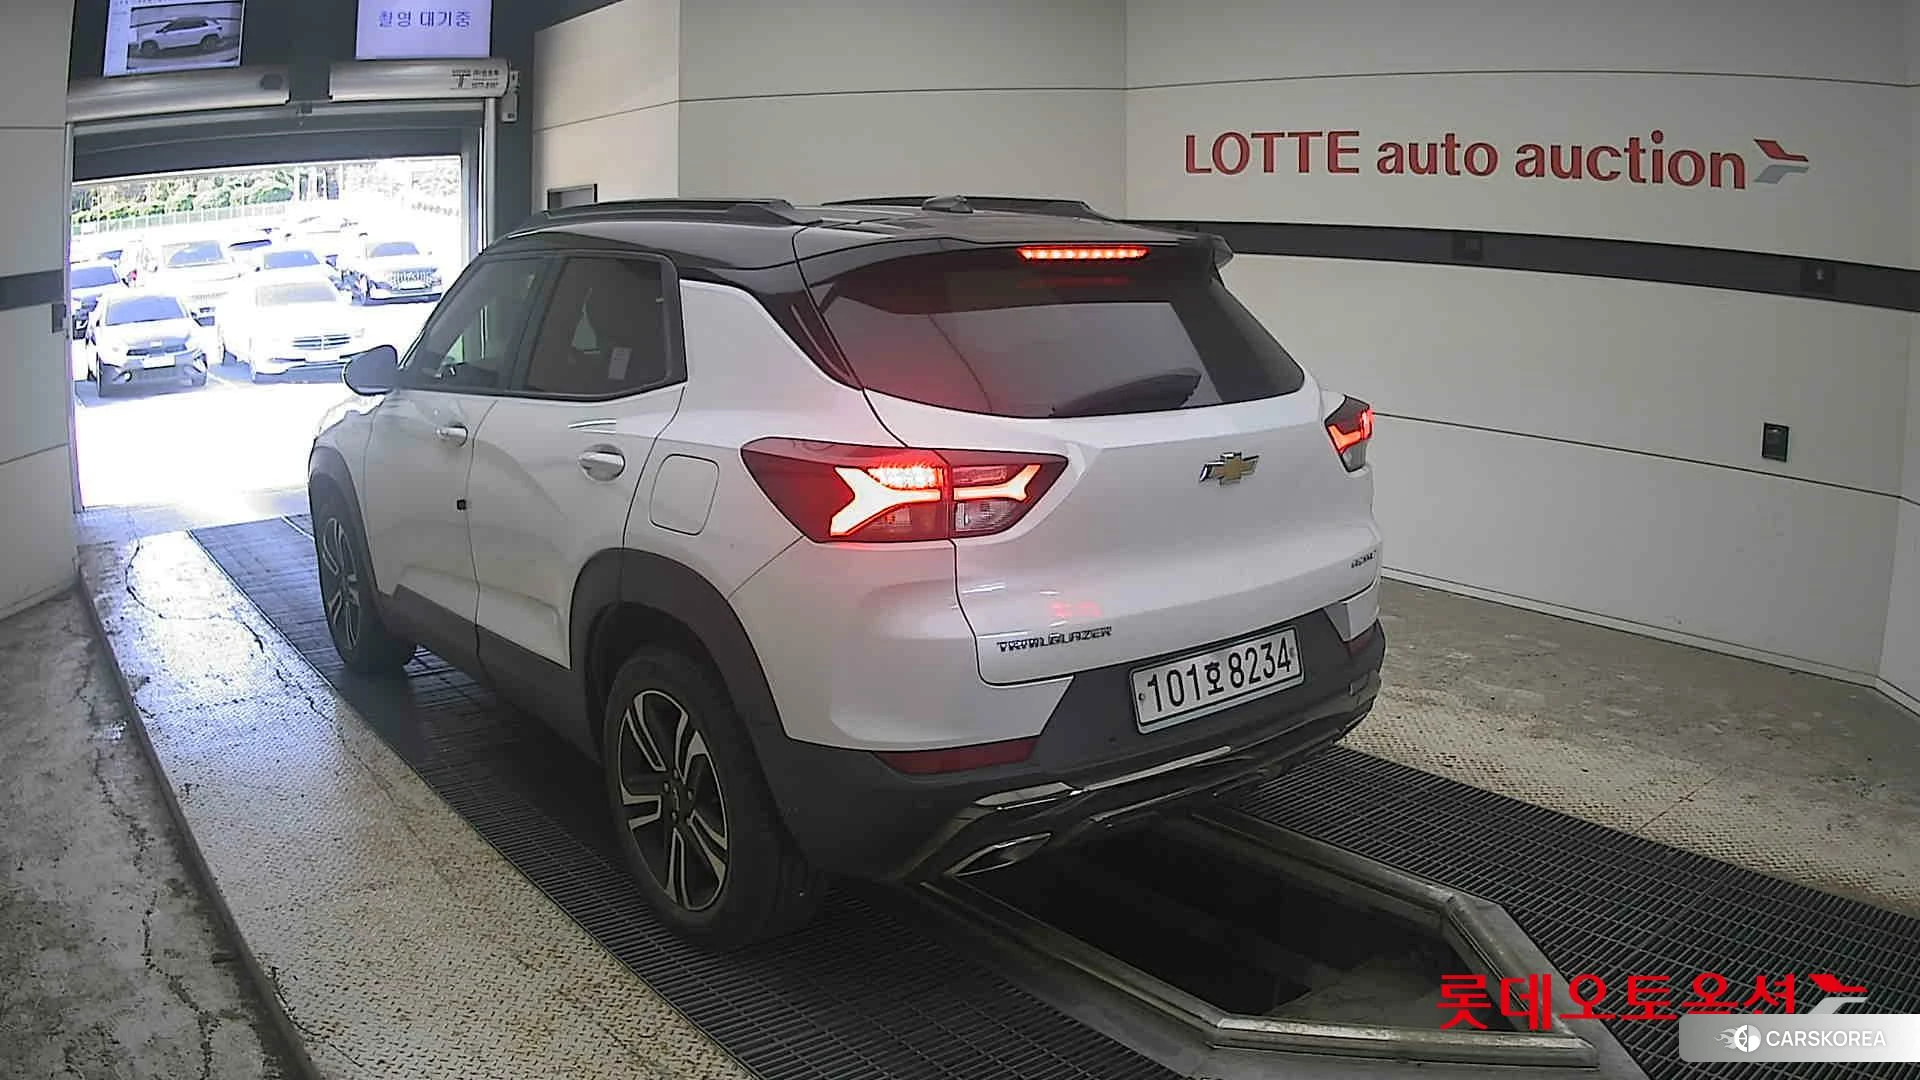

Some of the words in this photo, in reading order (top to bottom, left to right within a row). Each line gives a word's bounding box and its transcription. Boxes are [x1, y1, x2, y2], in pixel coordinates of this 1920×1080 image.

[420, 10, 472, 28] 대기중
[1185, 130, 1360, 175] LOTTE
[1376, 132, 1499, 177] auto
[1514, 129, 1746, 190] auction
